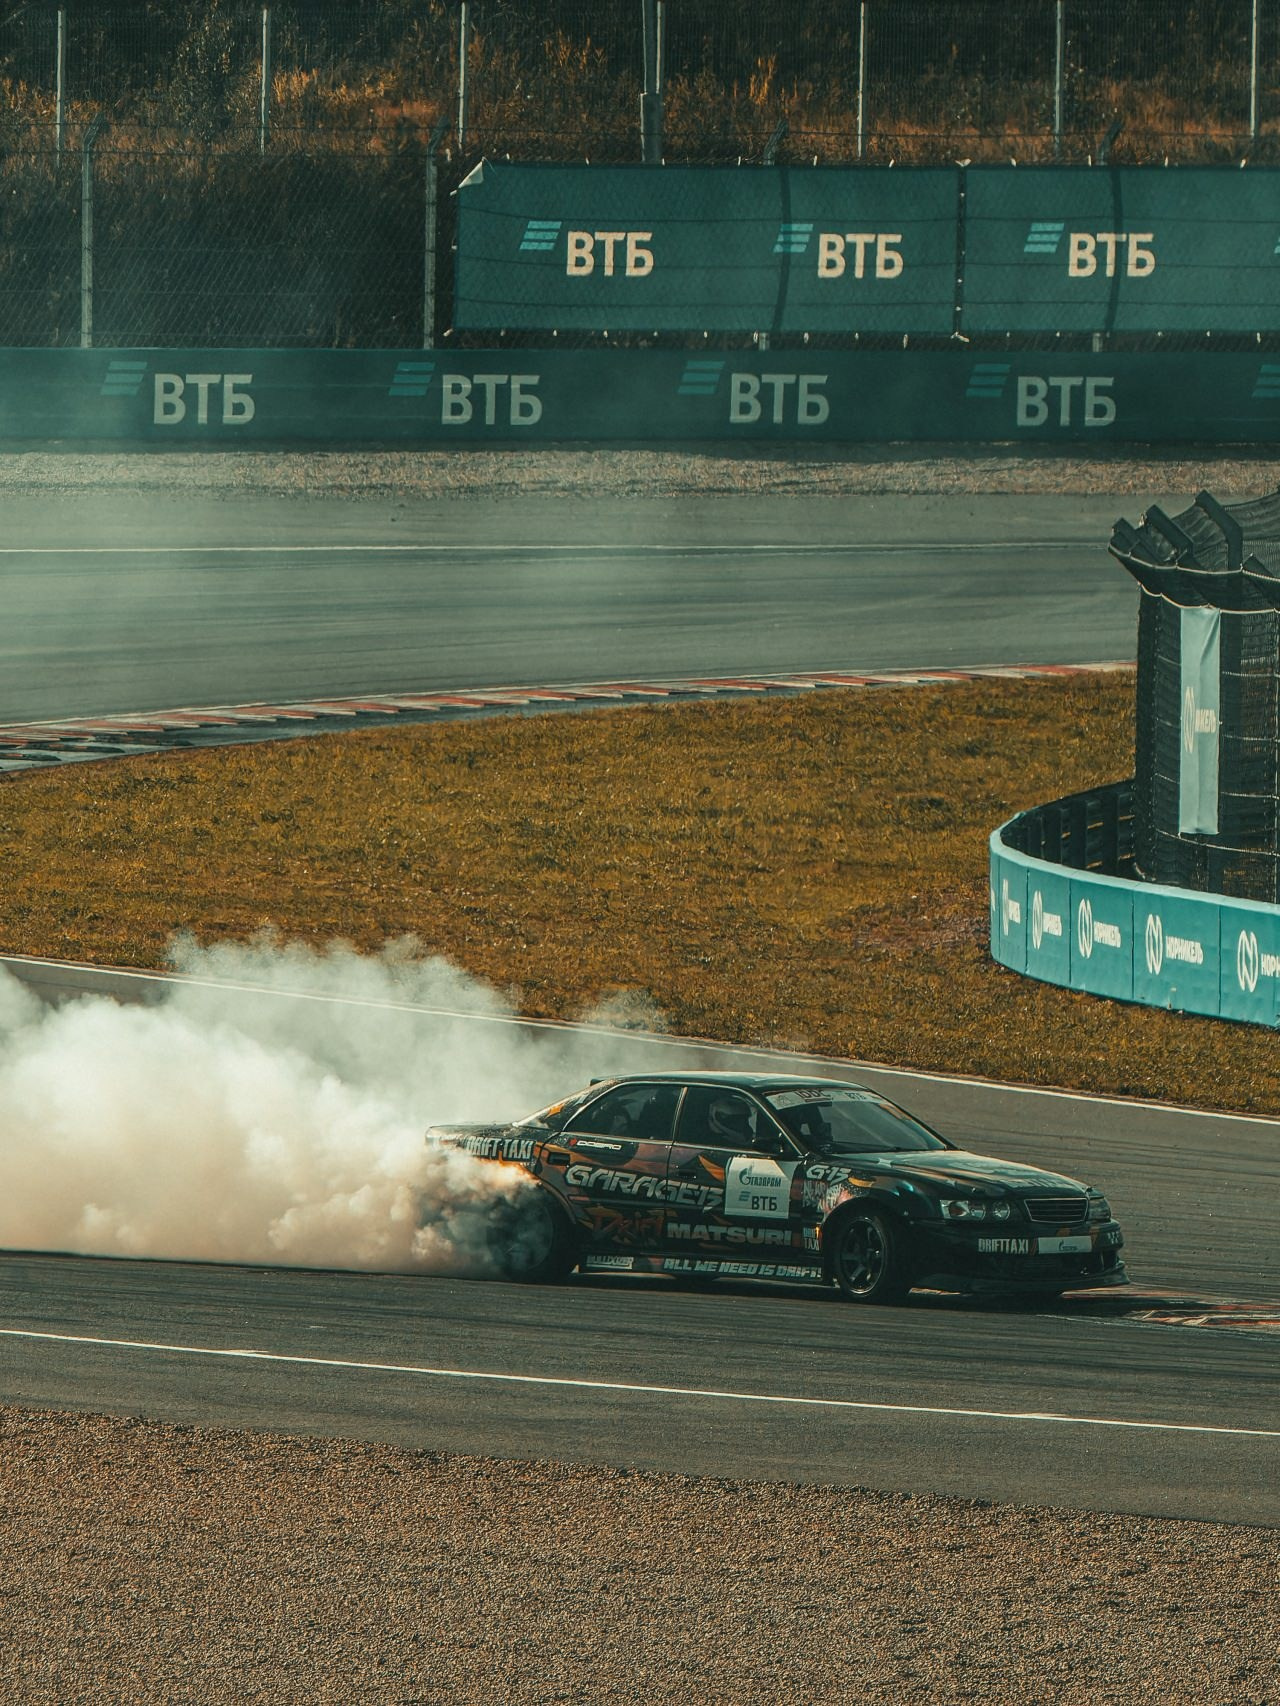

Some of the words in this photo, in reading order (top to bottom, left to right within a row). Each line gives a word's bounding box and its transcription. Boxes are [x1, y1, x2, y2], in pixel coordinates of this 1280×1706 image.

[567, 232, 653, 277] ВТБ
[818, 234, 904, 278] ВТБ
[1069, 233, 1155, 277] ВТБ
[154, 373, 254, 424] ВТБ
[442, 374, 542, 425] ВТБ
[730, 373, 830, 424] ВТБ
[1017, 375, 1117, 426] ВТБ
[503, 1139, 534, 1159] TAXI
[750, 1177, 781, 1187] ГАЗПРОМ
[751, 1195, 778, 1211] ВТБ
[667, 1222, 792, 1247] MATSURI
[663, 1258, 693, 1271] ALL
[694, 1260, 718, 1272] WE
[718, 1262, 759, 1274] NEED
[759, 1264, 776, 1276] IS
